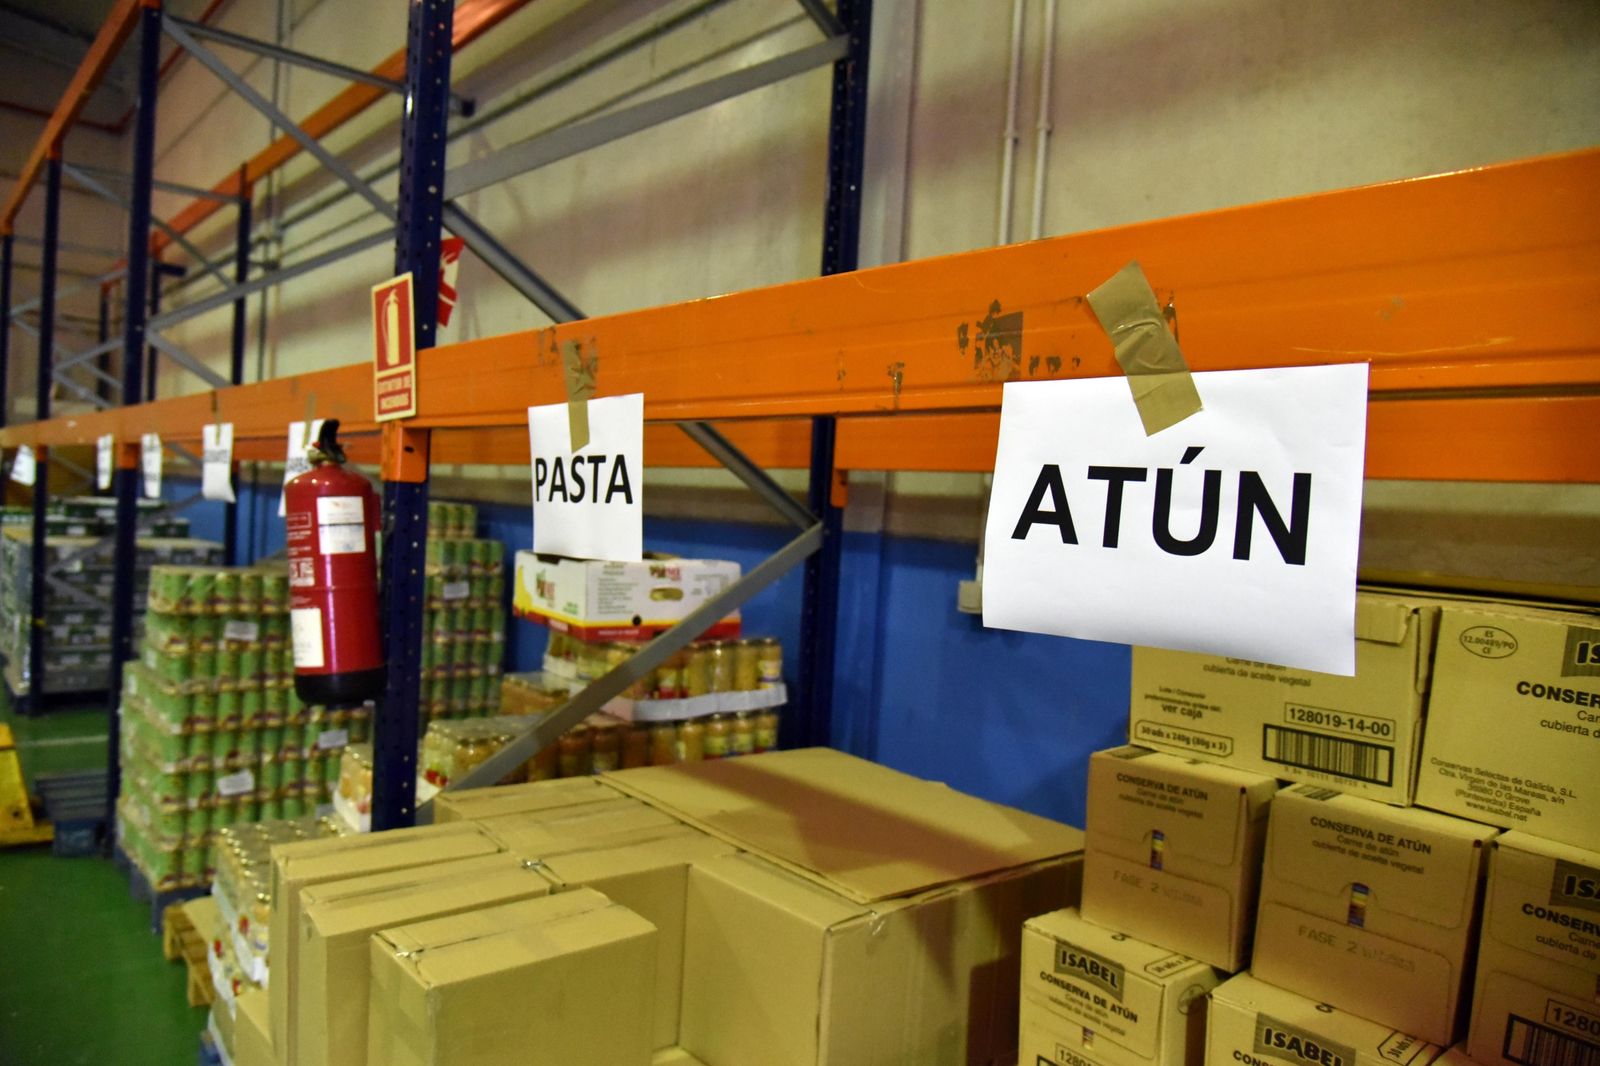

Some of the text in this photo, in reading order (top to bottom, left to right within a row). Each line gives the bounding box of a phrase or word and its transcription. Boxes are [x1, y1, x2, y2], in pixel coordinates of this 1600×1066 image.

[535, 454, 633, 504] PASTA
[1011, 446, 1312, 566] ATÚN
[1161, 704, 1203, 719] ver caja
[1289, 707, 1390, 737] 128019-14-00
[1540, 719, 1590, 736] cubierta
[1116, 772, 1208, 801] CONSERVA DE ATÚN
[1512, 776, 1523, 786] de
[1310, 815, 1432, 855] CONSERVA DE ATÚN
[1298, 925, 1357, 954] FASE 2
[1535, 934, 1597, 960] cubierta de
[1061, 950, 1118, 989] ISABEL
[1040, 971, 1138, 1023] CONSERVA DE ATÚN
